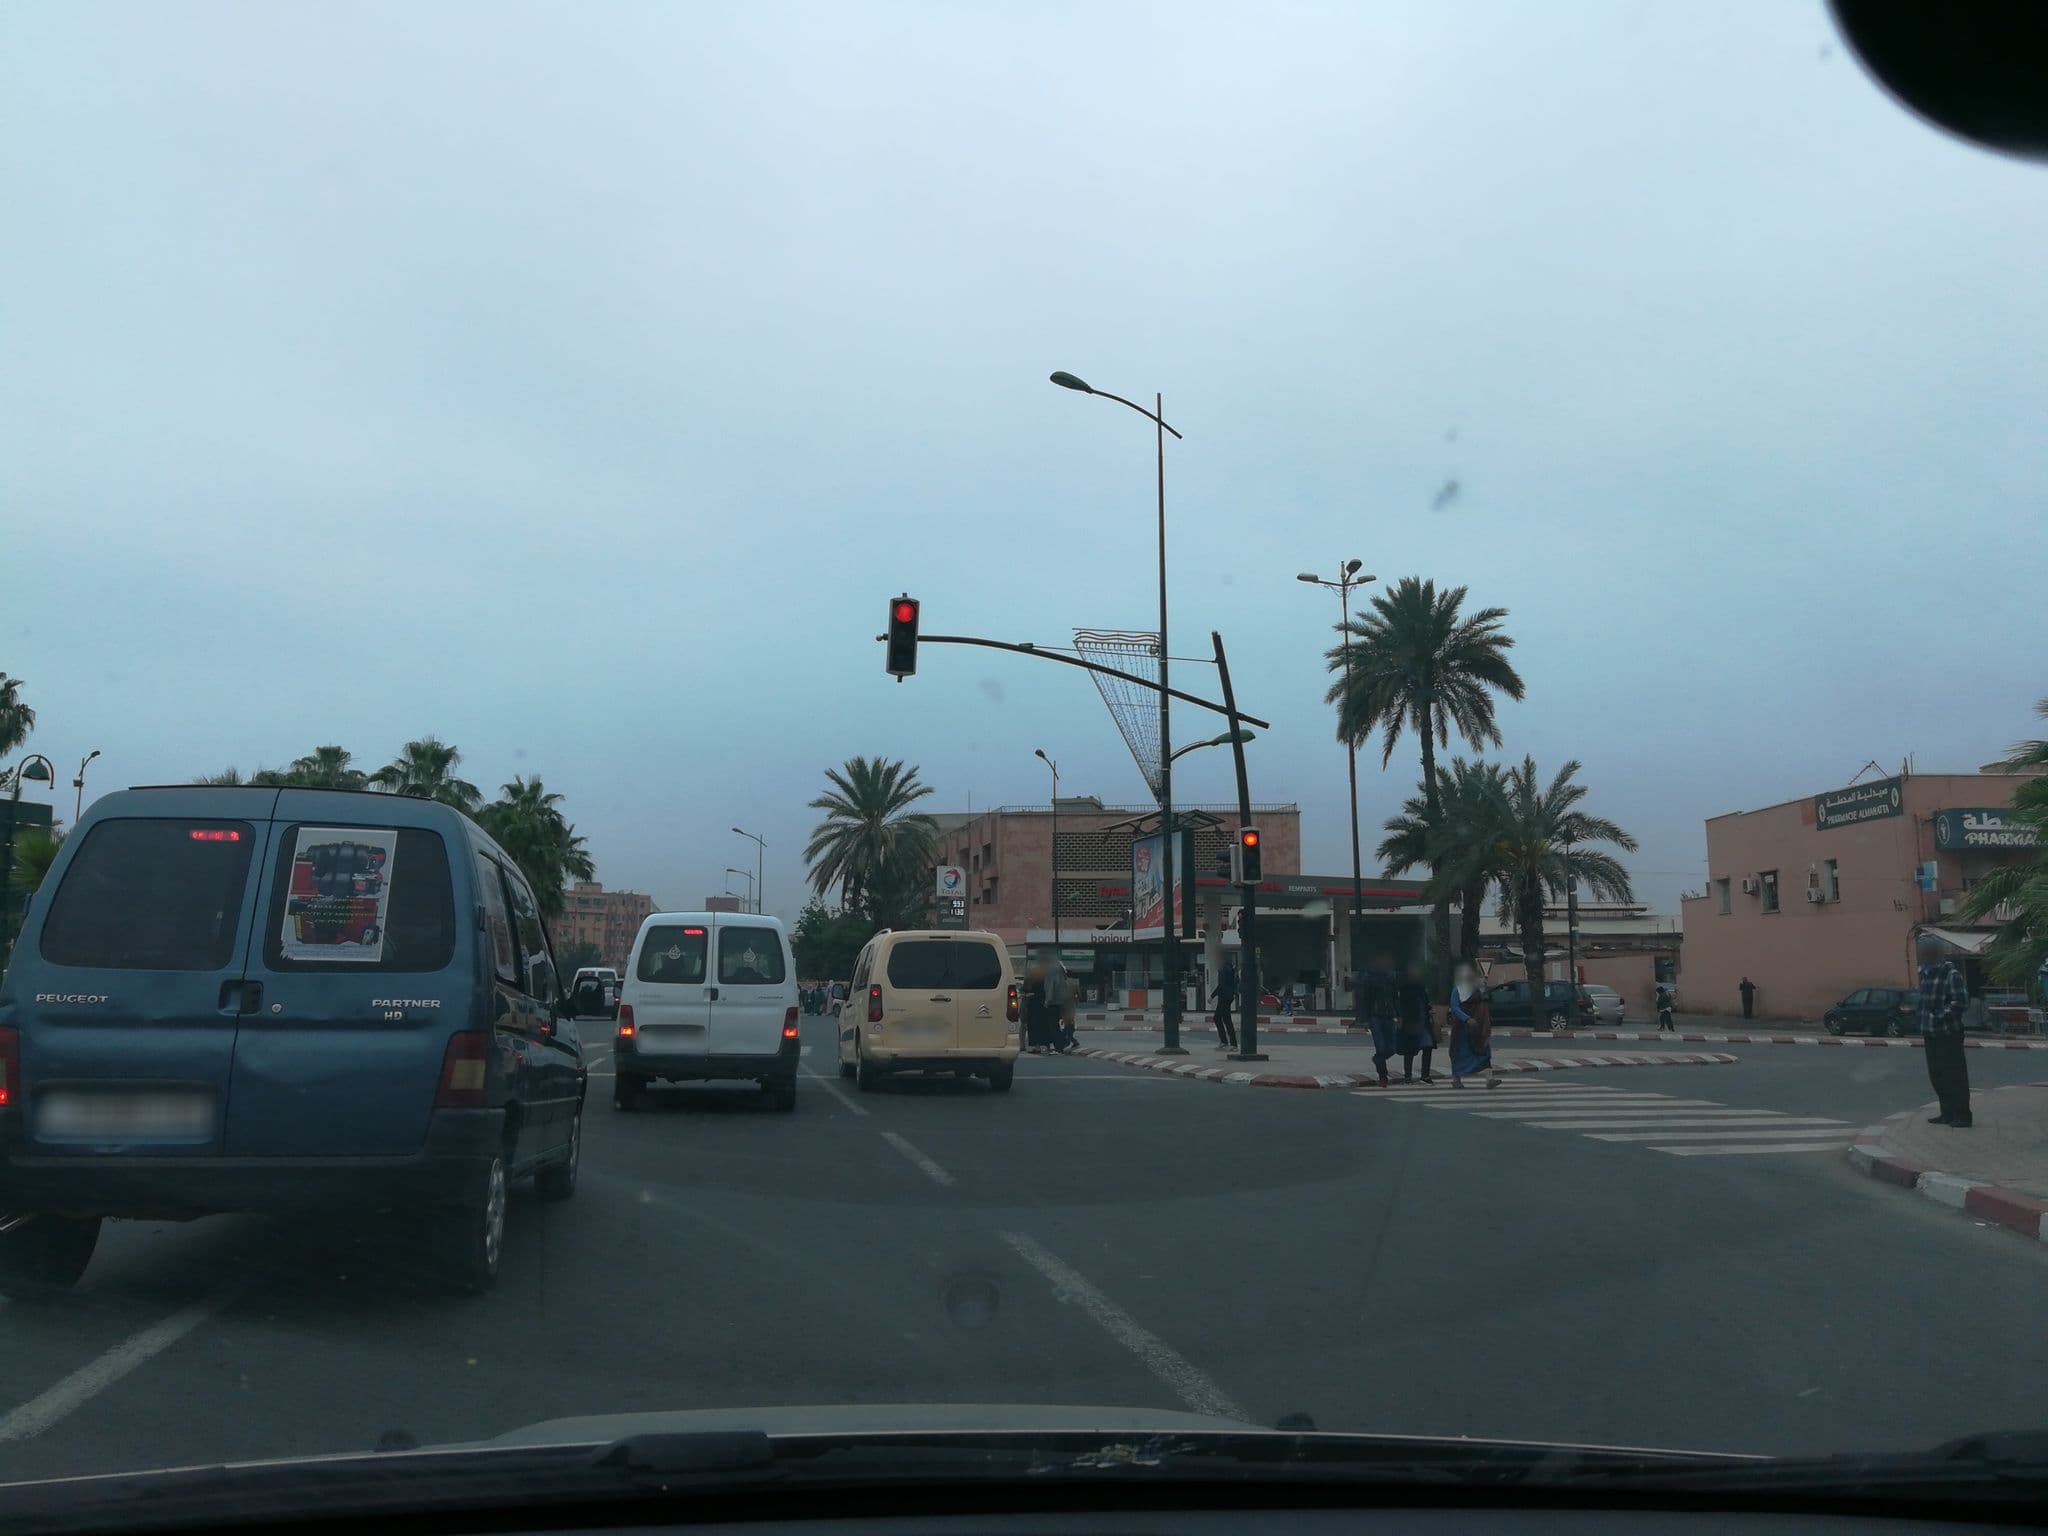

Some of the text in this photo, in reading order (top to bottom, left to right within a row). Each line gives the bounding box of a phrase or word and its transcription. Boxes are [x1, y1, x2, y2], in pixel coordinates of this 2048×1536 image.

[1090, 933, 1130, 944] bonjour
[35, 993, 109, 1004] PEUGEOT
[371, 999, 441, 1008] PARTNER
[384, 1011, 403, 1021] HD
